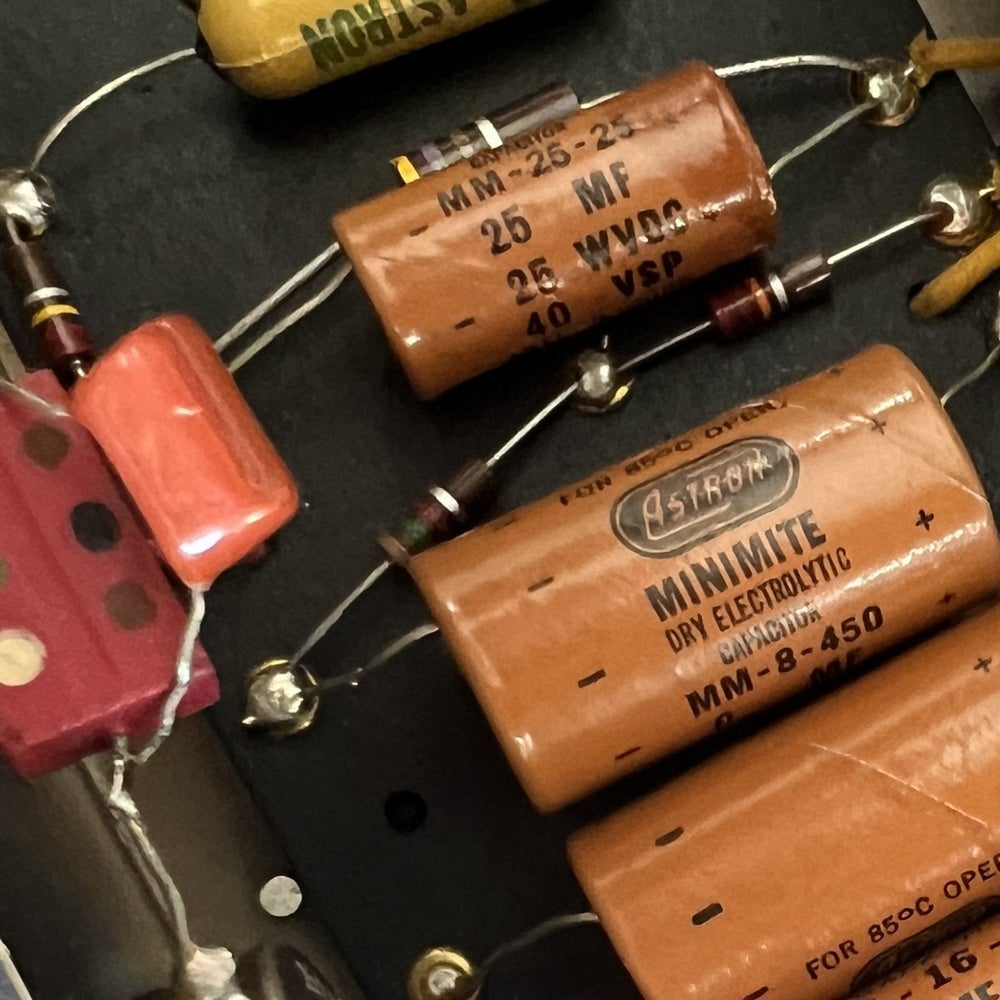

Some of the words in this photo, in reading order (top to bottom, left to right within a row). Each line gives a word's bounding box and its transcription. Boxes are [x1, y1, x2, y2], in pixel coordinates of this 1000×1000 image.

[436, 114, 636, 218] MM-25-25
[480, 204, 532, 257] 25
[571, 160, 631, 216] MF
[506, 256, 558, 307] 25
[572, 198, 688, 272] WVDC
[526, 301, 572, 336] 40
[611, 250, 683, 297] VSP
[644, 509, 828, 623] MINIMITE
[664, 613, 708, 654] DRY
[712, 546, 852, 633] ELECTROLYTIC
[684, 604, 885, 719] MM-8-450
[717, 602, 823, 666] CAPACITOR
[805, 938, 860, 981] FOR
